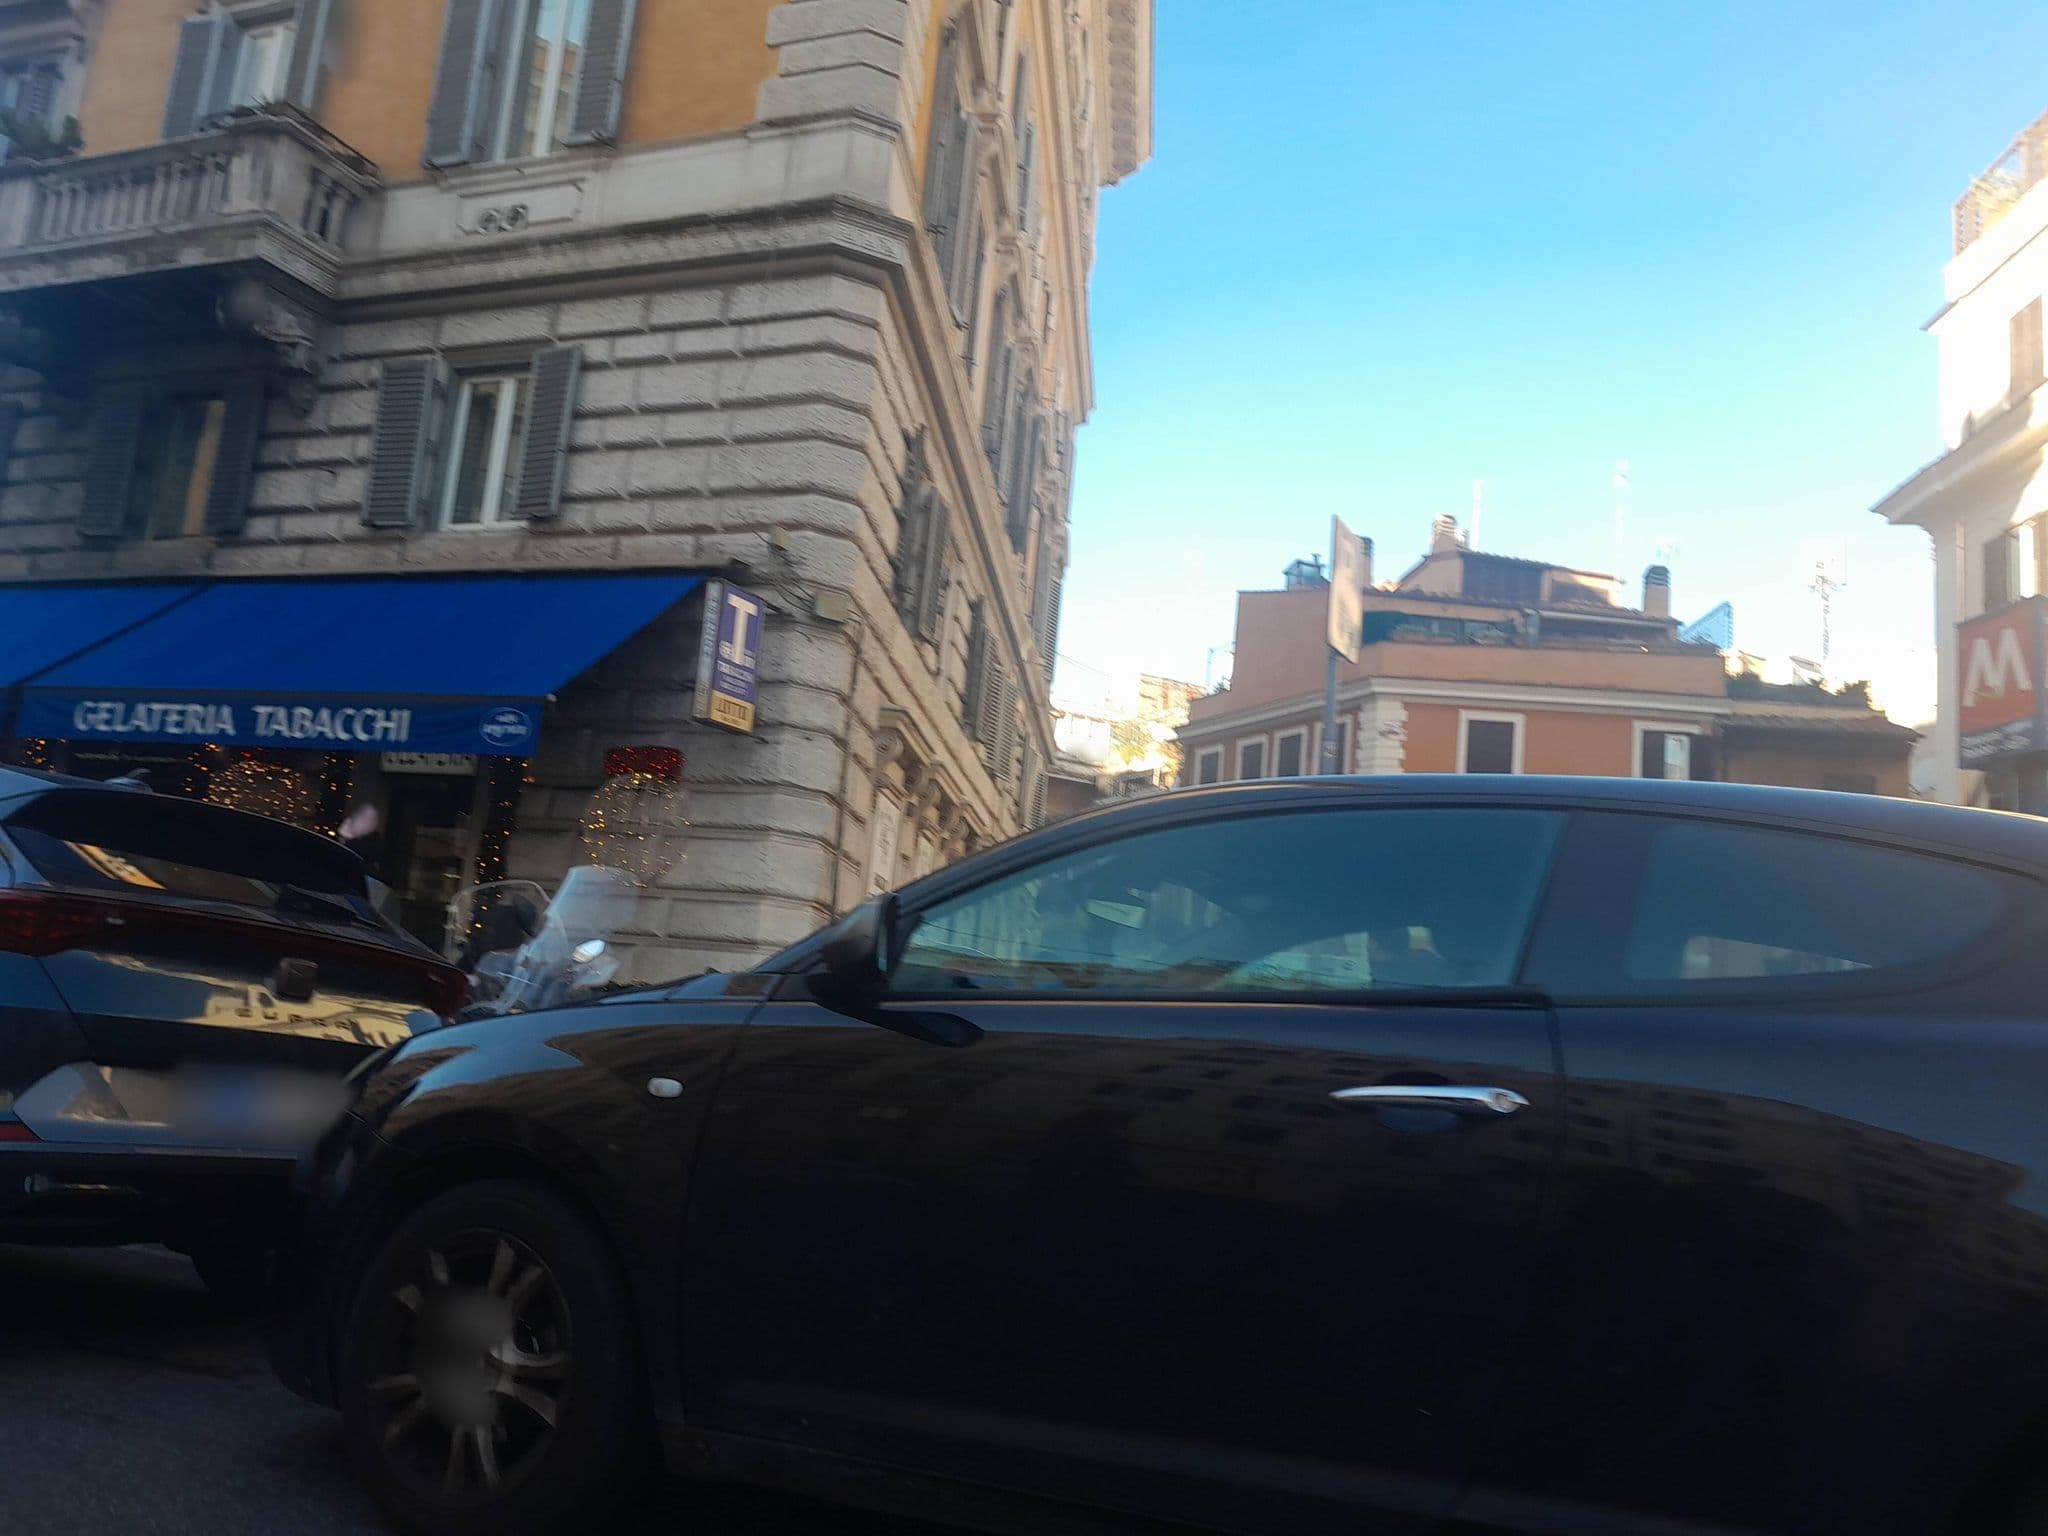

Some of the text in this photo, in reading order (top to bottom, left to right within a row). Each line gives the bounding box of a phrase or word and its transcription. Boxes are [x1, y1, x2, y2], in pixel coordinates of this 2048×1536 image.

[727, 593, 758, 662] T
[1962, 628, 2034, 708] M
[73, 701, 412, 742] GELATERIA TABACCHI
